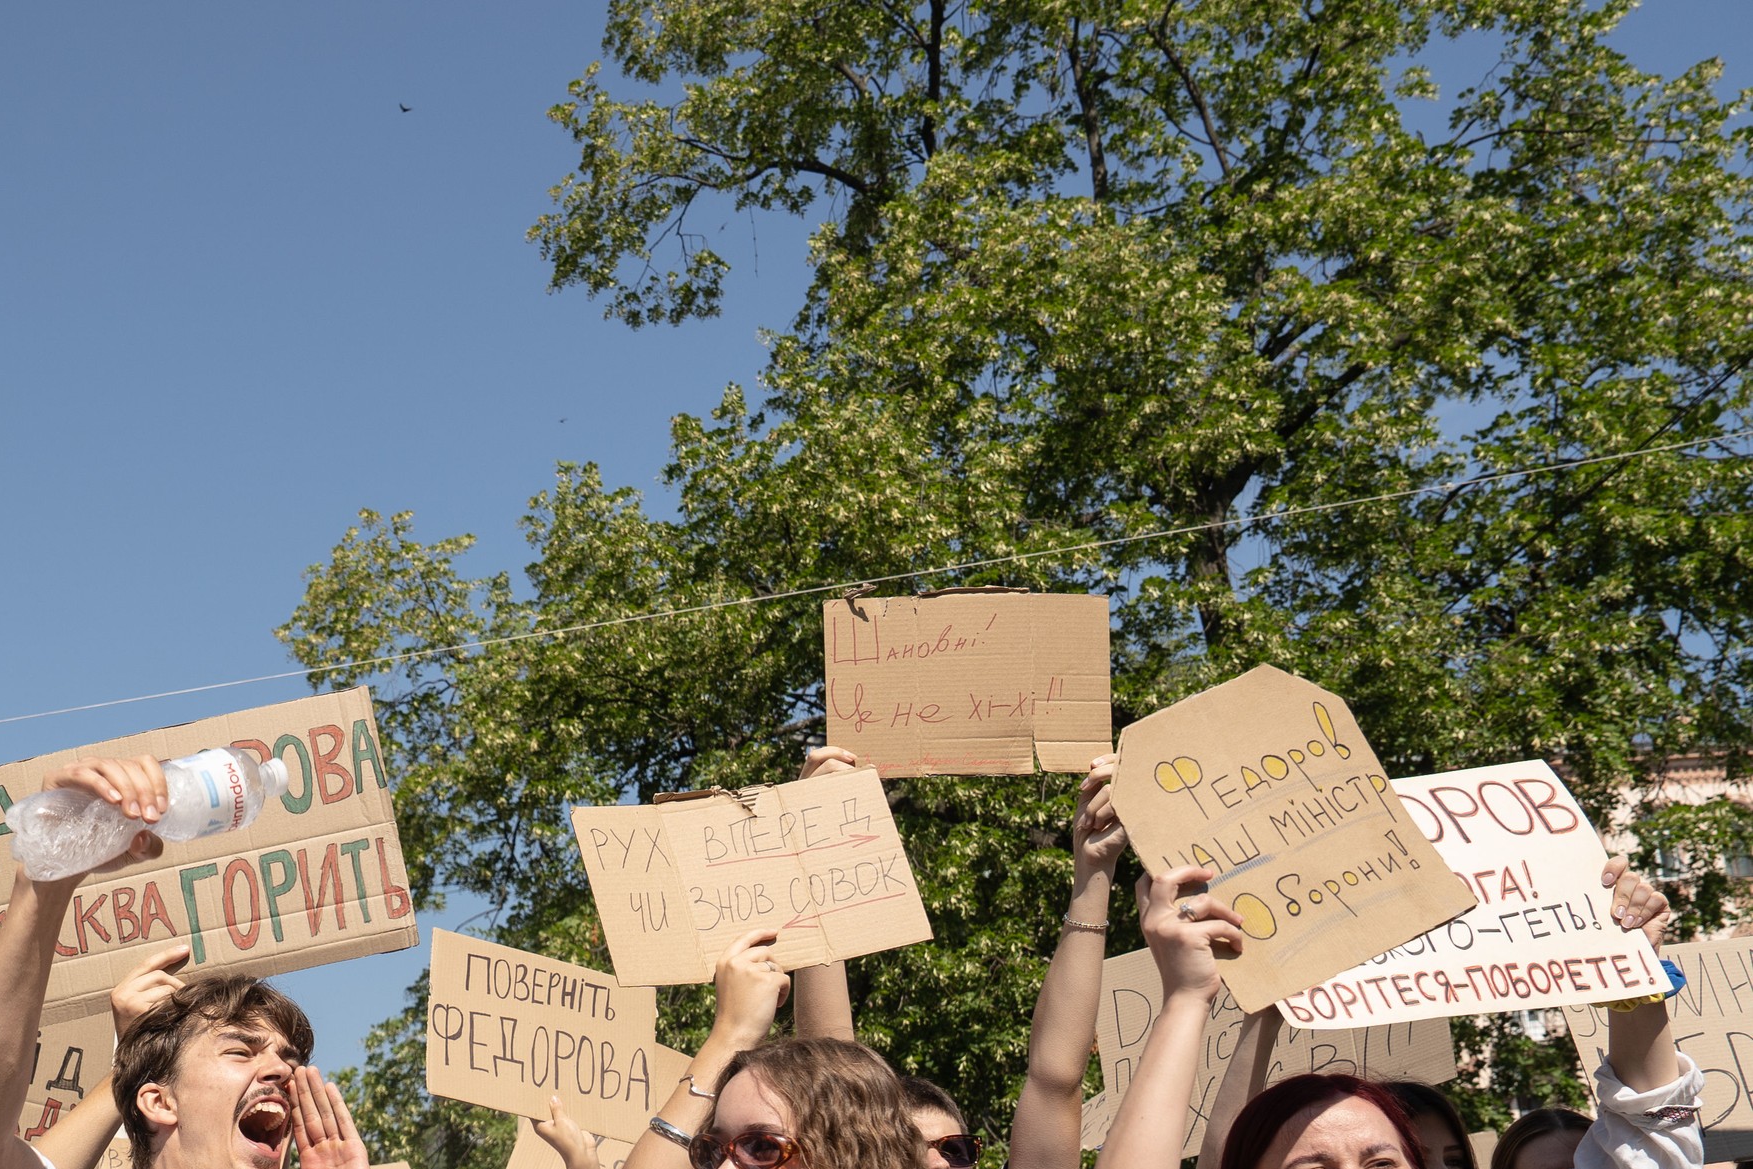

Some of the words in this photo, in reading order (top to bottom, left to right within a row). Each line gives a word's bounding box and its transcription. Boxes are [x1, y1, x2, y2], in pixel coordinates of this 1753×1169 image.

[589, 827, 671, 873] РУХ
[703, 797, 871, 864] ВПЕРЕД
[179, 837, 411, 965] ГОРИТЬ
[630, 891, 669, 933] ЧИ
[689, 883, 776, 931] ЗНОВ
[789, 853, 908, 914] СОВОК
[1453, 859, 1540, 906] ГА!
[432, 1001, 650, 1112] ФЕДОРОВА
